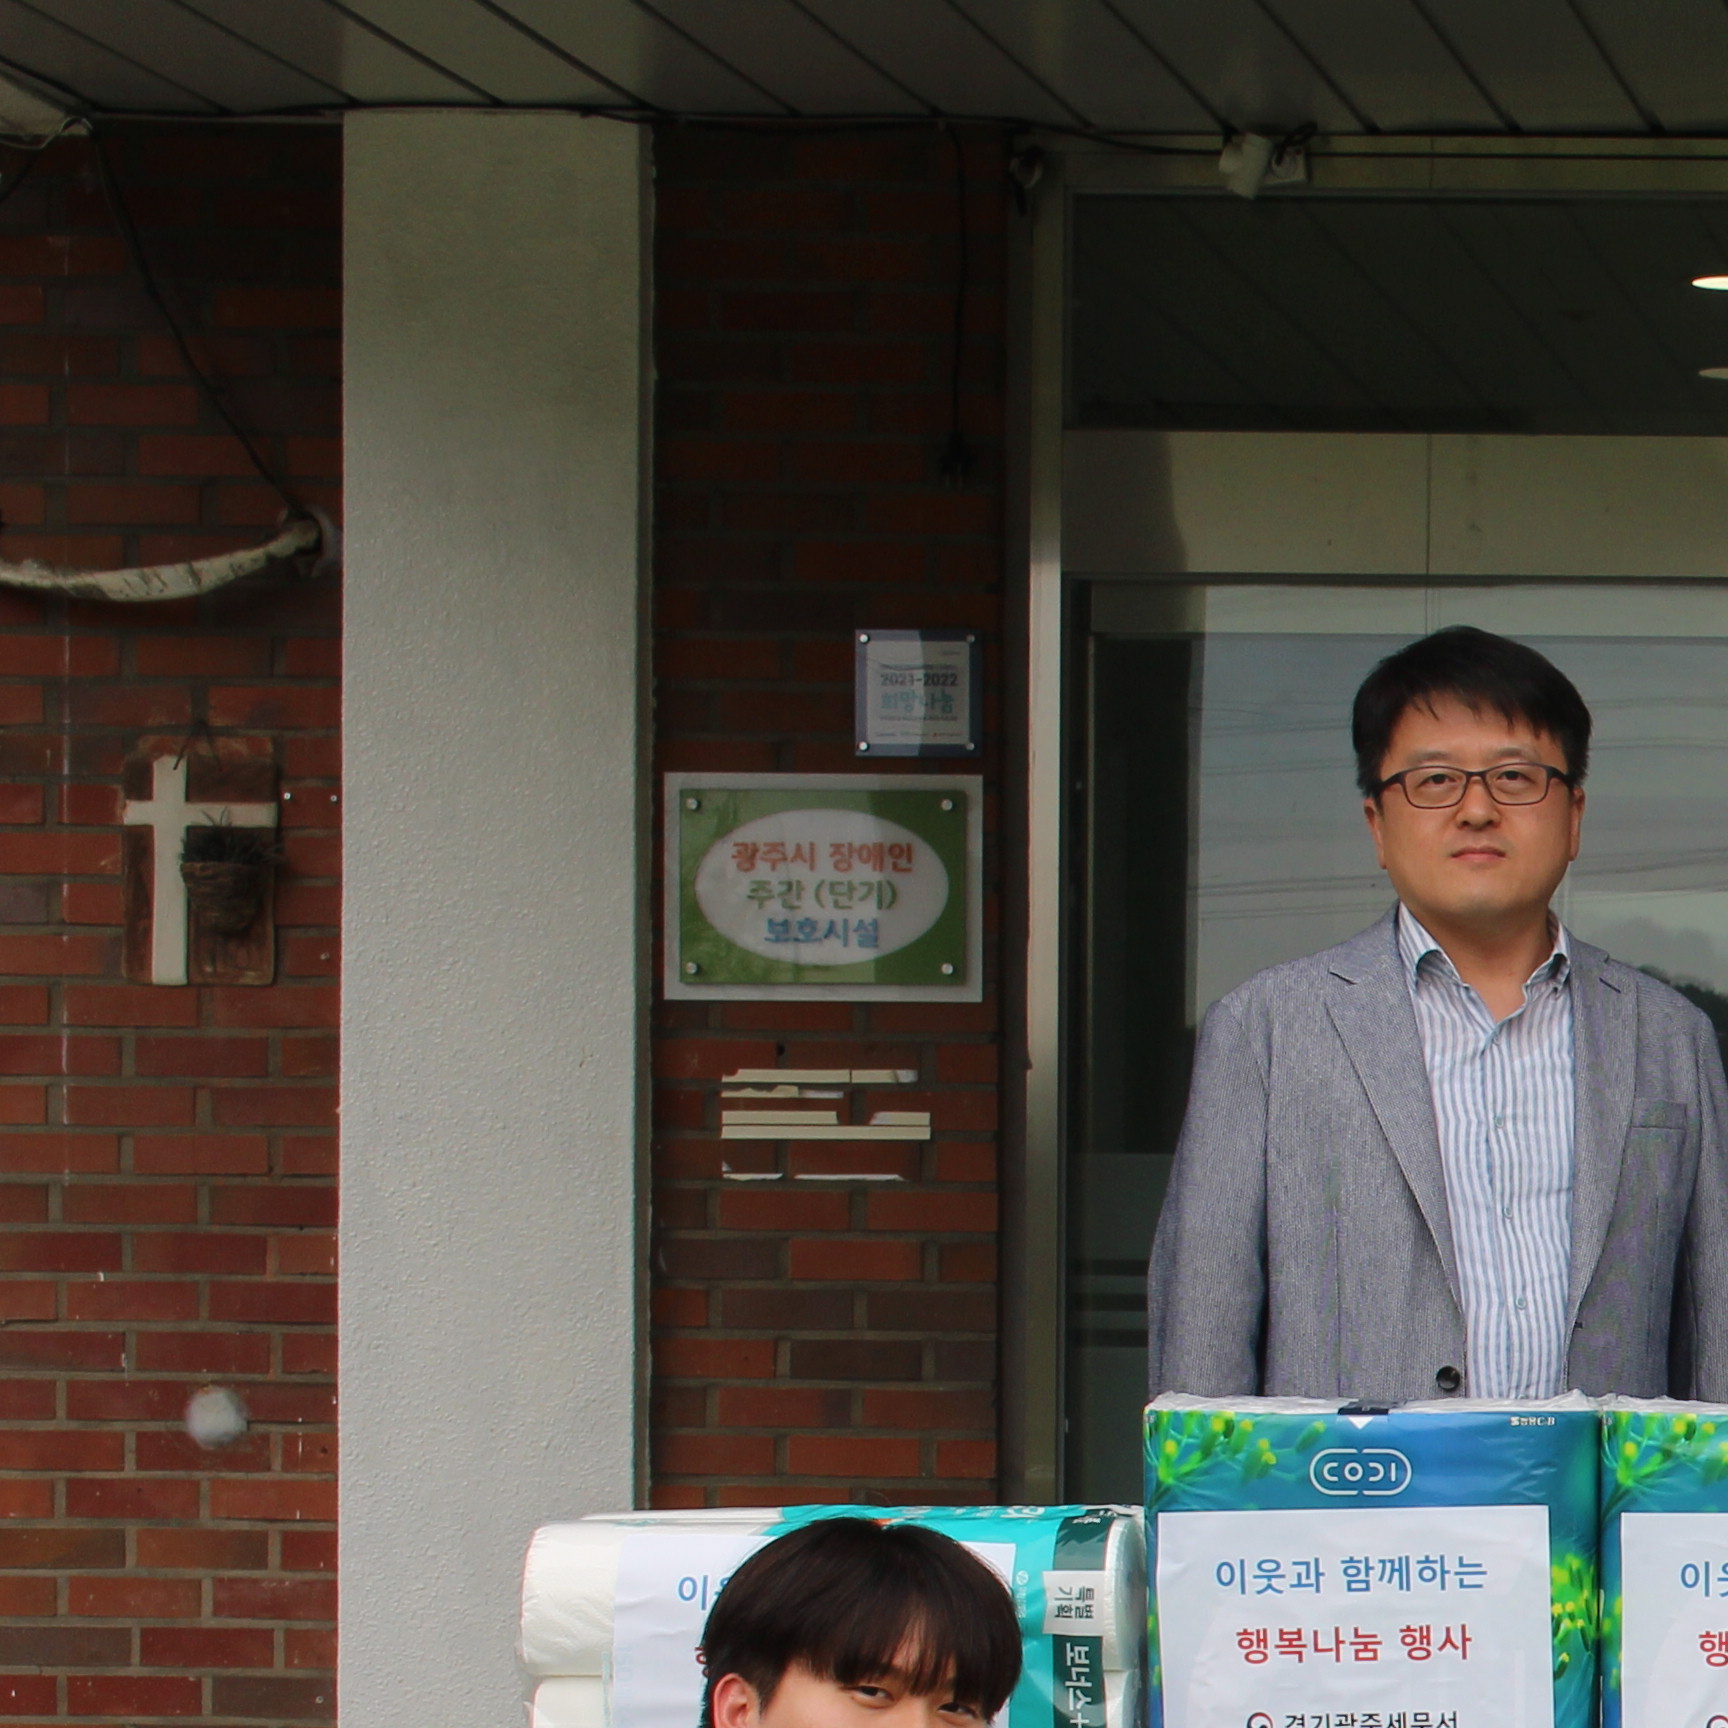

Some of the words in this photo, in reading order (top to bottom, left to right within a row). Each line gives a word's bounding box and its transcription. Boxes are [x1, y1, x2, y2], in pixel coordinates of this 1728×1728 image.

[880, 672, 958, 687] 2021-2022
[881, 689, 954, 714] 희망나눔
[731, 842, 816, 873] 광주시
[829, 842, 913, 873] 장애인
[747, 879, 805, 910] 주간
[814, 879, 897, 910] (단기)
[764, 917, 879, 948] 보호시설
[1323, 1461, 1396, 1483] CODI
[1214, 1556, 1325, 1596] 이웃과
[1340, 1553, 1488, 1595] 함께하는
[1054, 1586, 1076, 1620] 기획
[1073, 1585, 1095, 1620] 특별
[1235, 1626, 1383, 1665] 행복나눔
[1399, 1623, 1473, 1663] 행사
